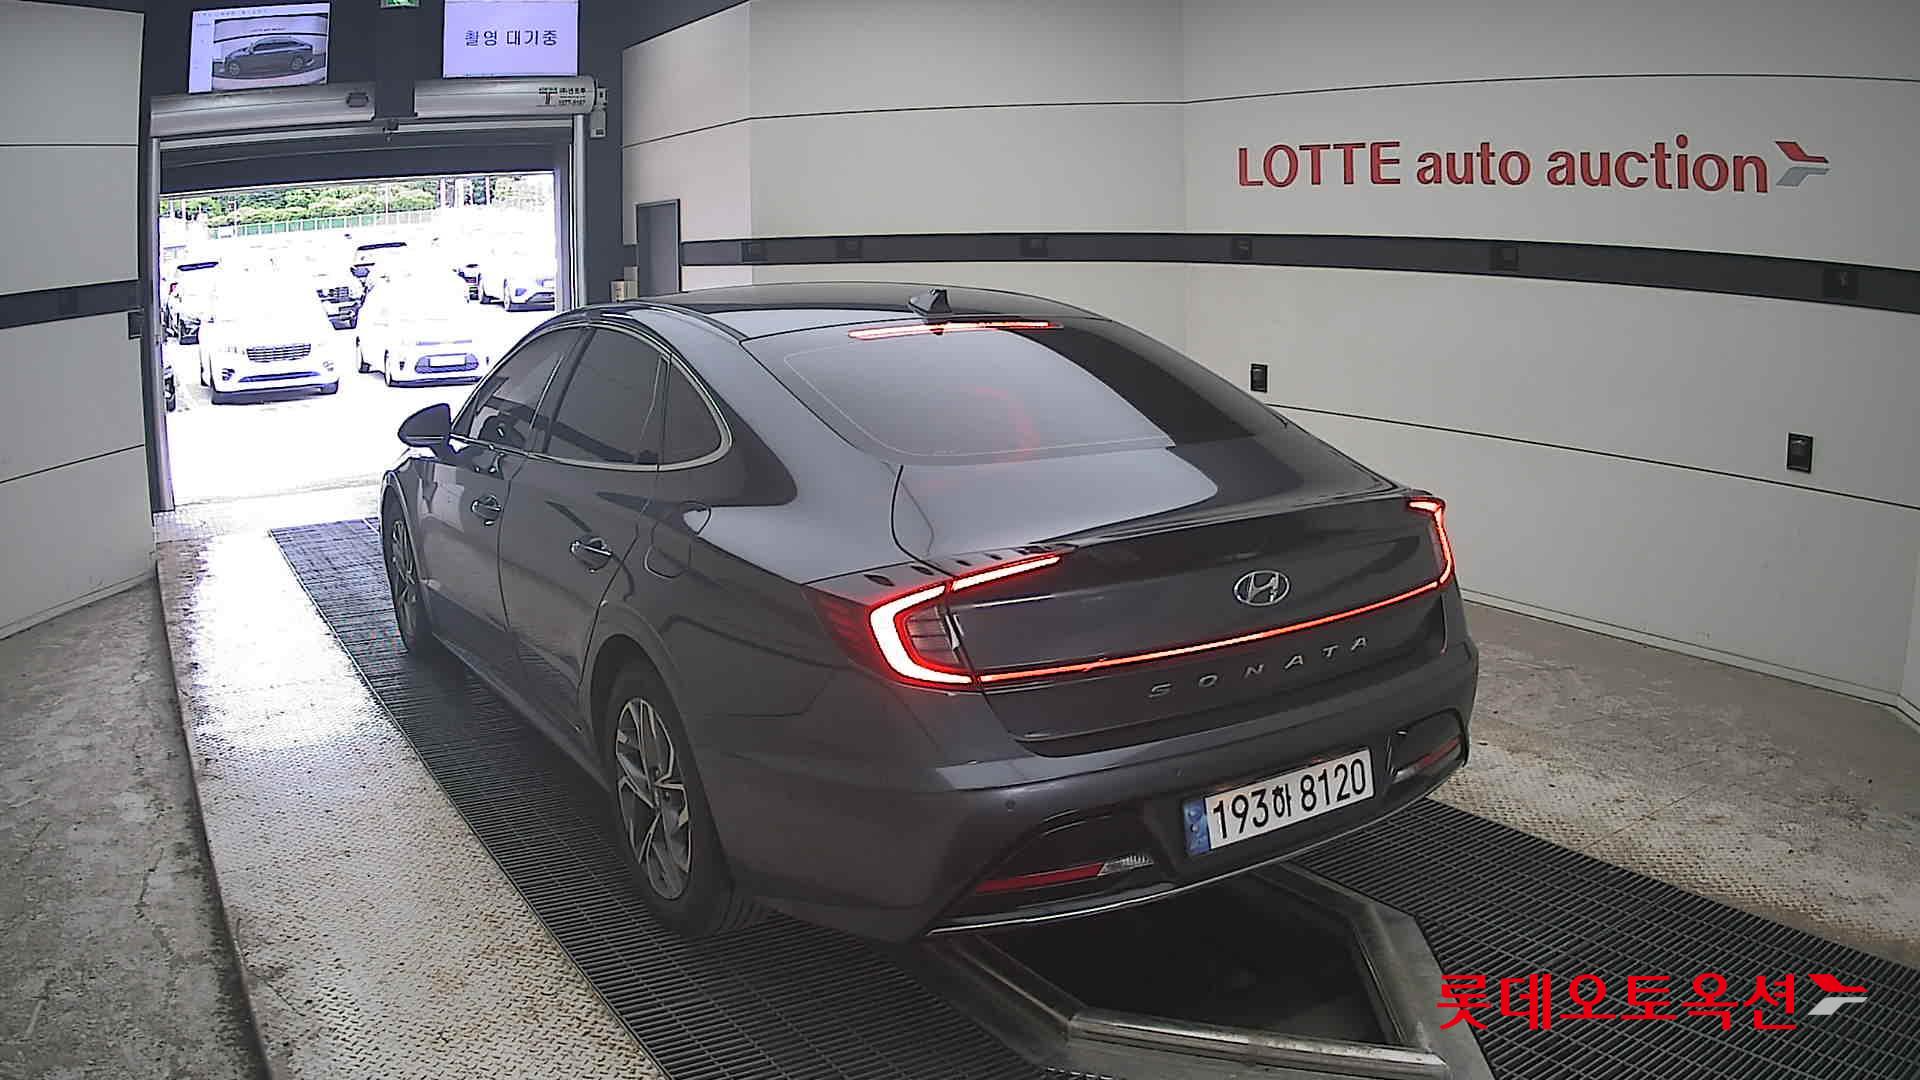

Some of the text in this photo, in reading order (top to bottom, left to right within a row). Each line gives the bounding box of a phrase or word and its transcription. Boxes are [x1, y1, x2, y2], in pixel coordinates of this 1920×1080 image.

[464, 30, 558, 46] 촬영 대기중
[1238, 134, 1768, 194] LOTTE auto auction
[1148, 636, 1370, 698] SONATA
[1212, 758, 1366, 840] 193하 8120
